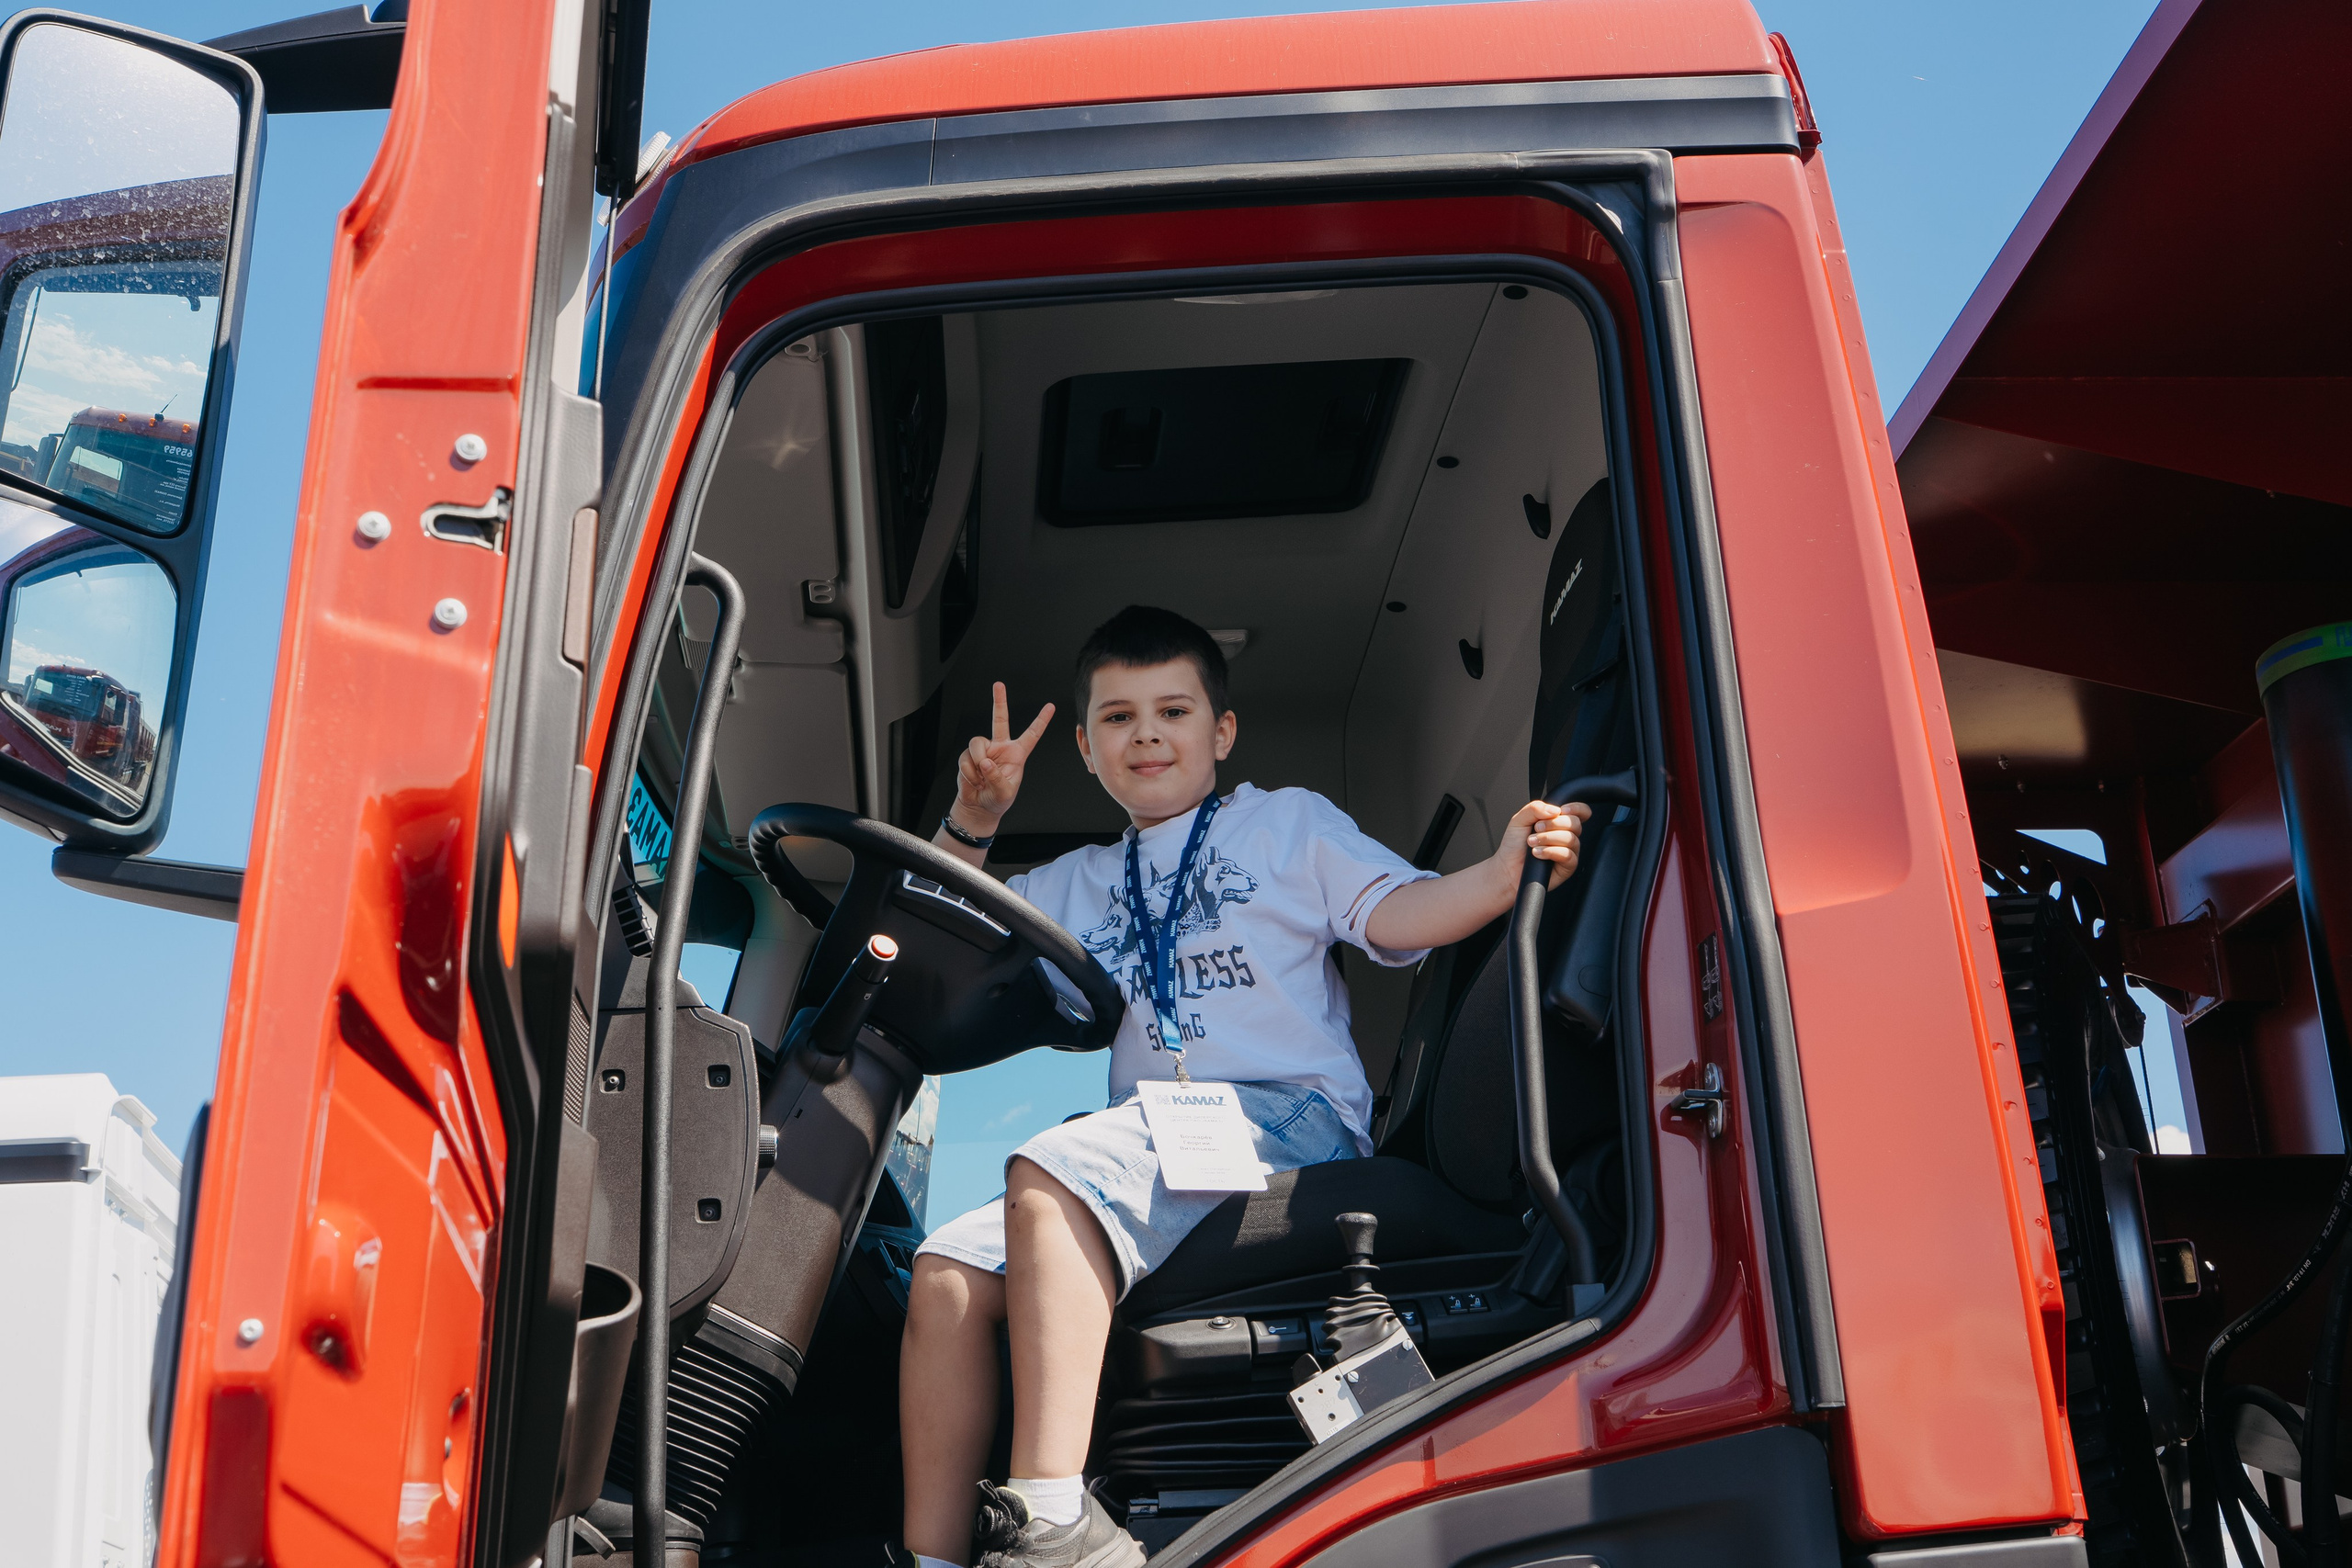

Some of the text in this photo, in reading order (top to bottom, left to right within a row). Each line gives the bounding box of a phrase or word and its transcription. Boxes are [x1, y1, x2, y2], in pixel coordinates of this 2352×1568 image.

[1550, 558, 1582, 626] KAMAZ
[1138, 939, 1147, 953] KAMAZ
[1144, 962, 1152, 976] KAMAZ
[1171, 1095, 1227, 1107] KAMAZ
